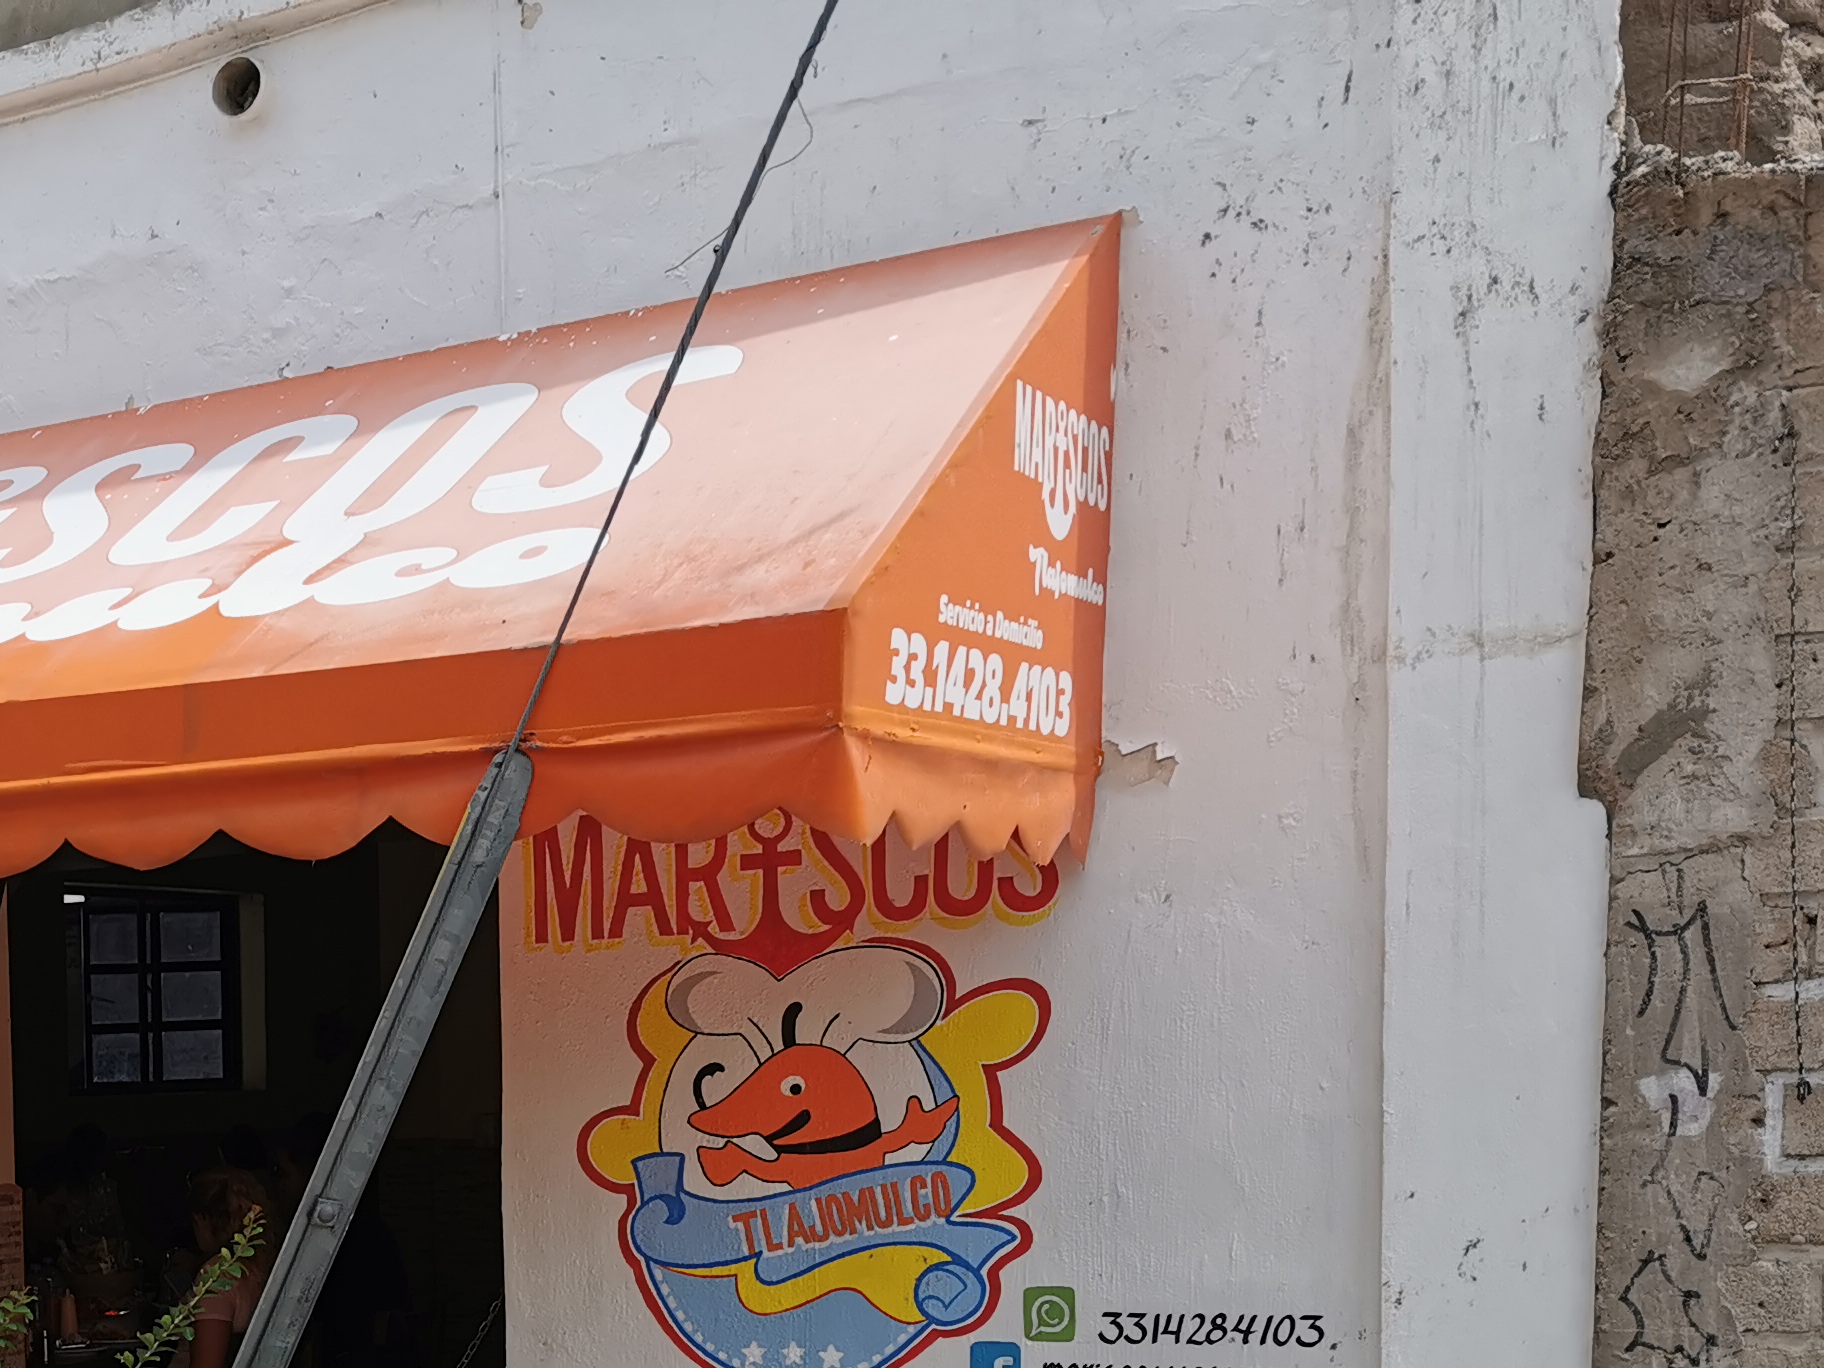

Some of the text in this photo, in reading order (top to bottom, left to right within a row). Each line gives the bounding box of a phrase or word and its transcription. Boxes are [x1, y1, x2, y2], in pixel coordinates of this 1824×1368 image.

[1013, 378, 1110, 540] MARISCOS
[938, 593, 1044, 650] Servicio a Domicilio
[884, 627, 1073, 738] 33.1428.4103
[728, 1170, 953, 1256] TLAJOMULCO
